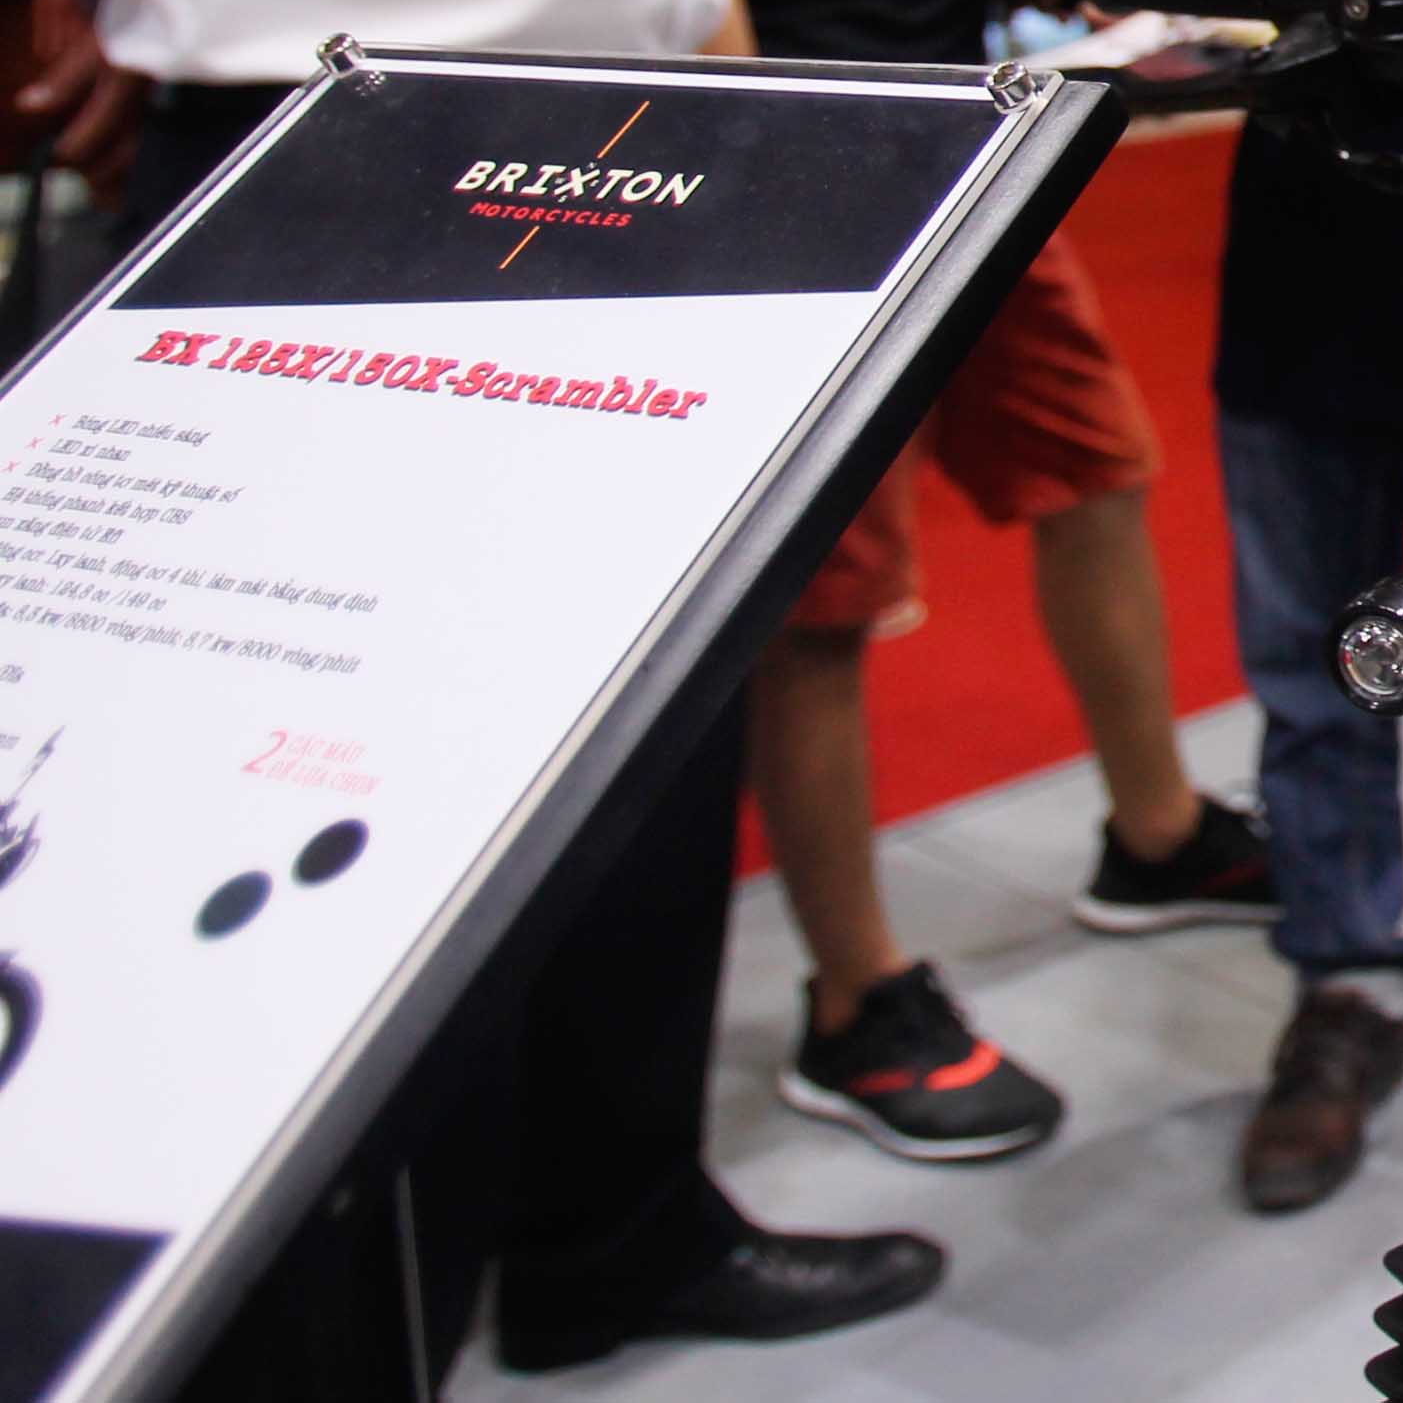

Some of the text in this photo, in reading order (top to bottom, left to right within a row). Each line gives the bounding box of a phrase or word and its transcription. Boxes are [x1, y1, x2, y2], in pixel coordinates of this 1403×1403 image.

[454, 160, 705, 206] BRIXTON
[468, 201, 633, 228] MOTORCYCLES
[135, 330, 708, 419] BX 125X/150X-Scrambler
[242, 728, 288, 773] 2
